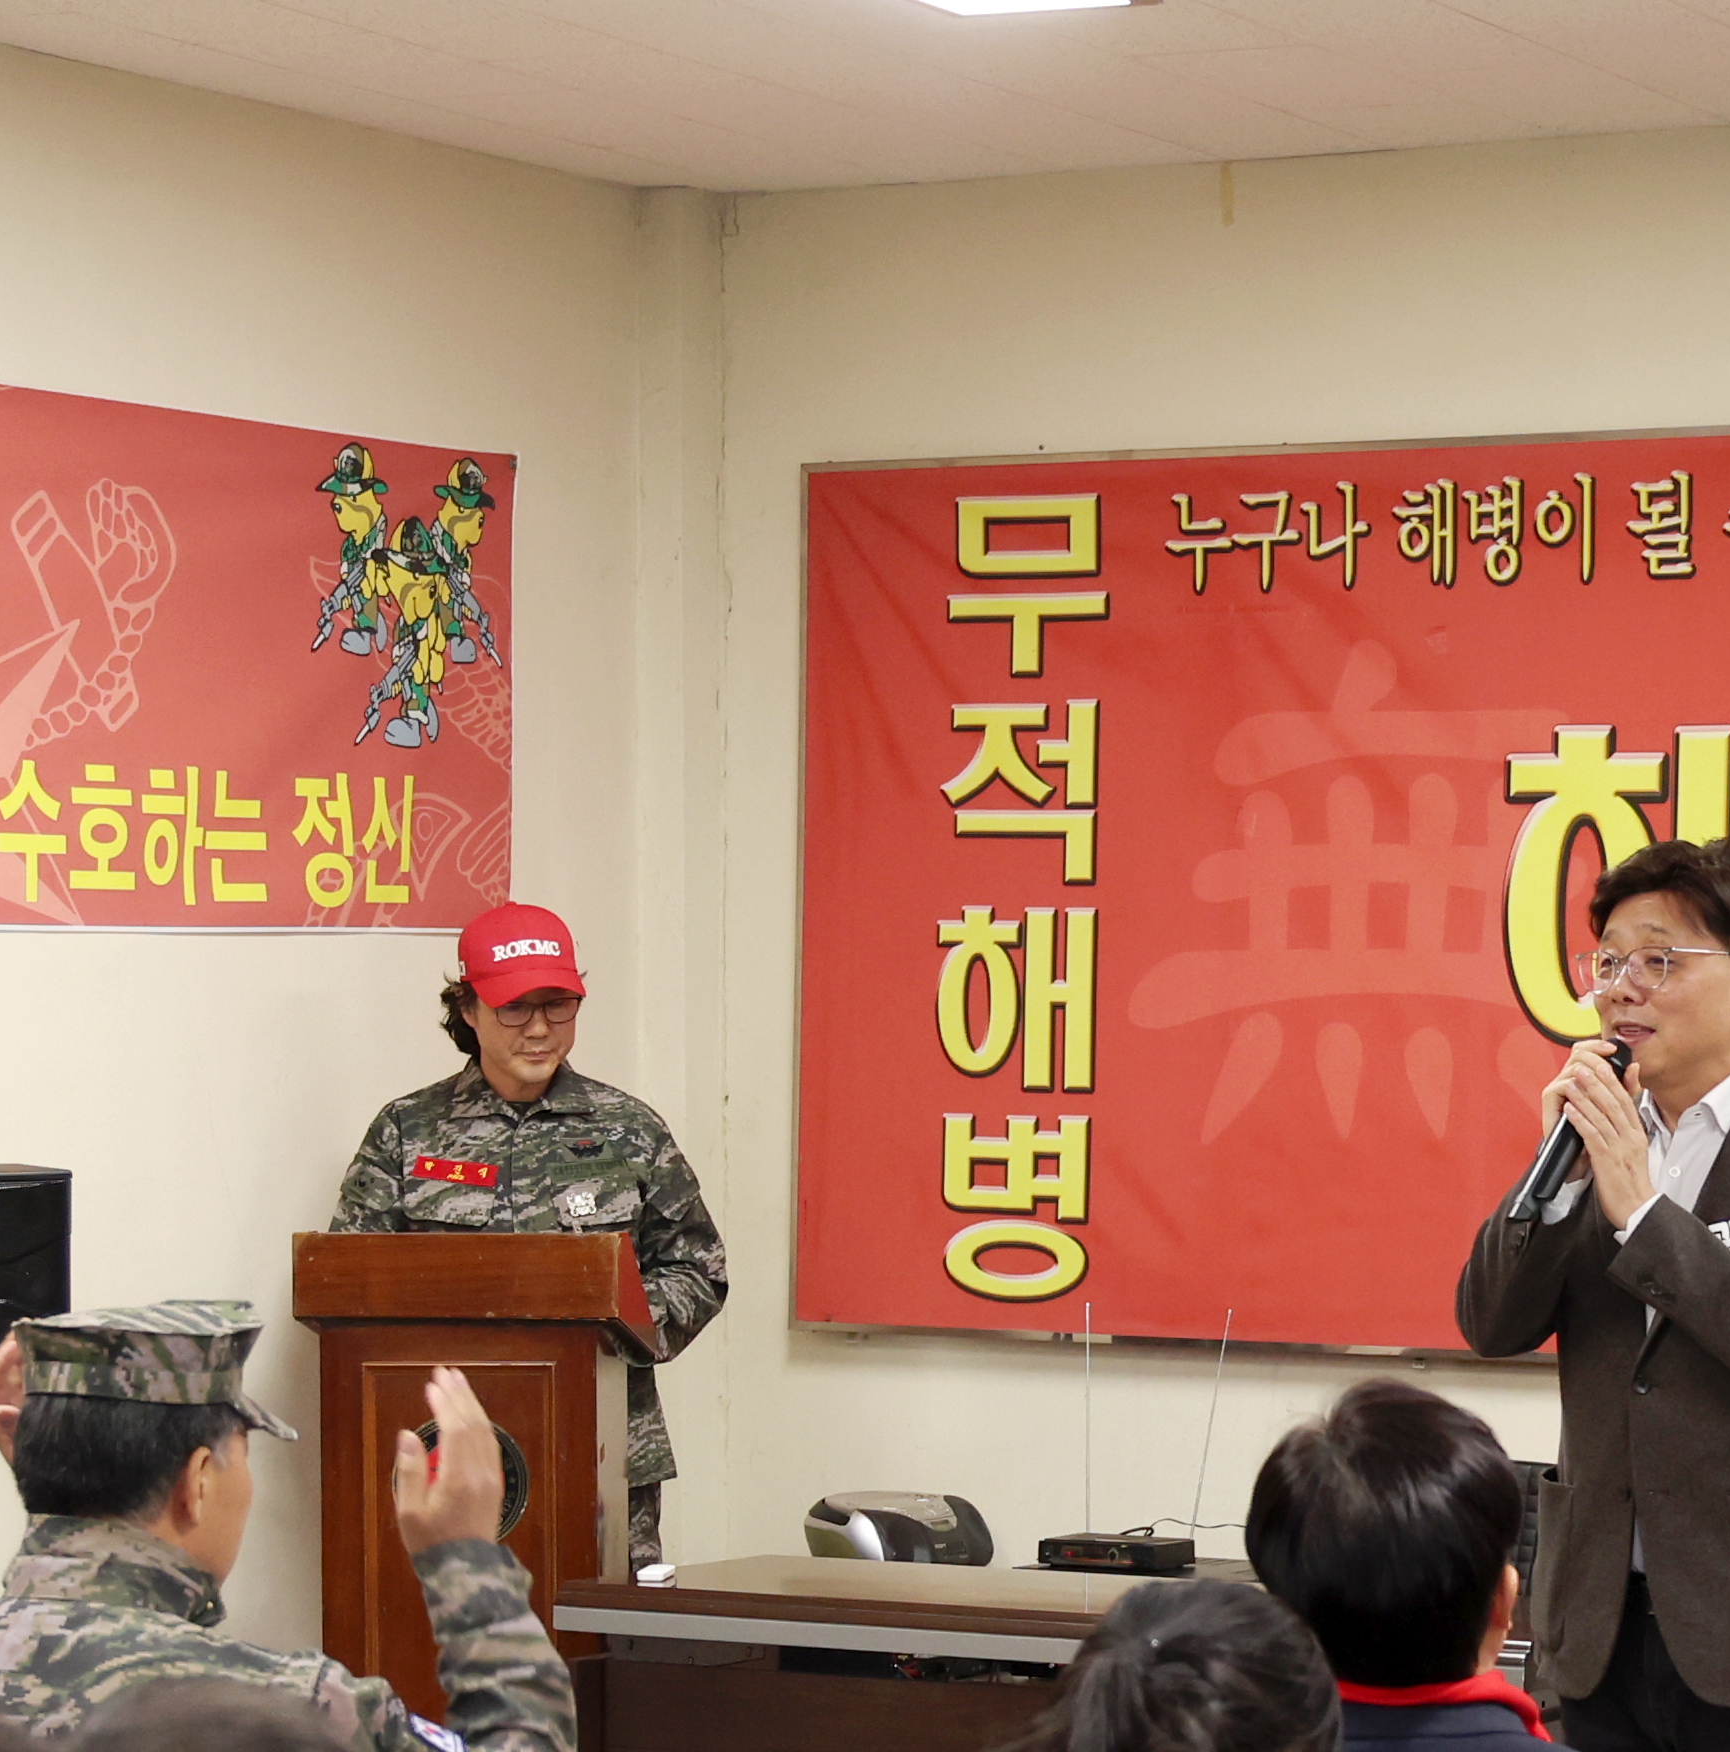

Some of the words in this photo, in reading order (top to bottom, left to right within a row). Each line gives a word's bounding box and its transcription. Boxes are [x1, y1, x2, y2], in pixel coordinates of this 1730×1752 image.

[1165, 480, 1370, 592] 누구나
[1396, 473, 1596, 584] 해병이
[1627, 470, 1696, 578] 될
[292, 772, 415, 909] 정신
[936, 493, 1109, 1302] 무적해병
[492, 939, 561, 962] ROKMC
